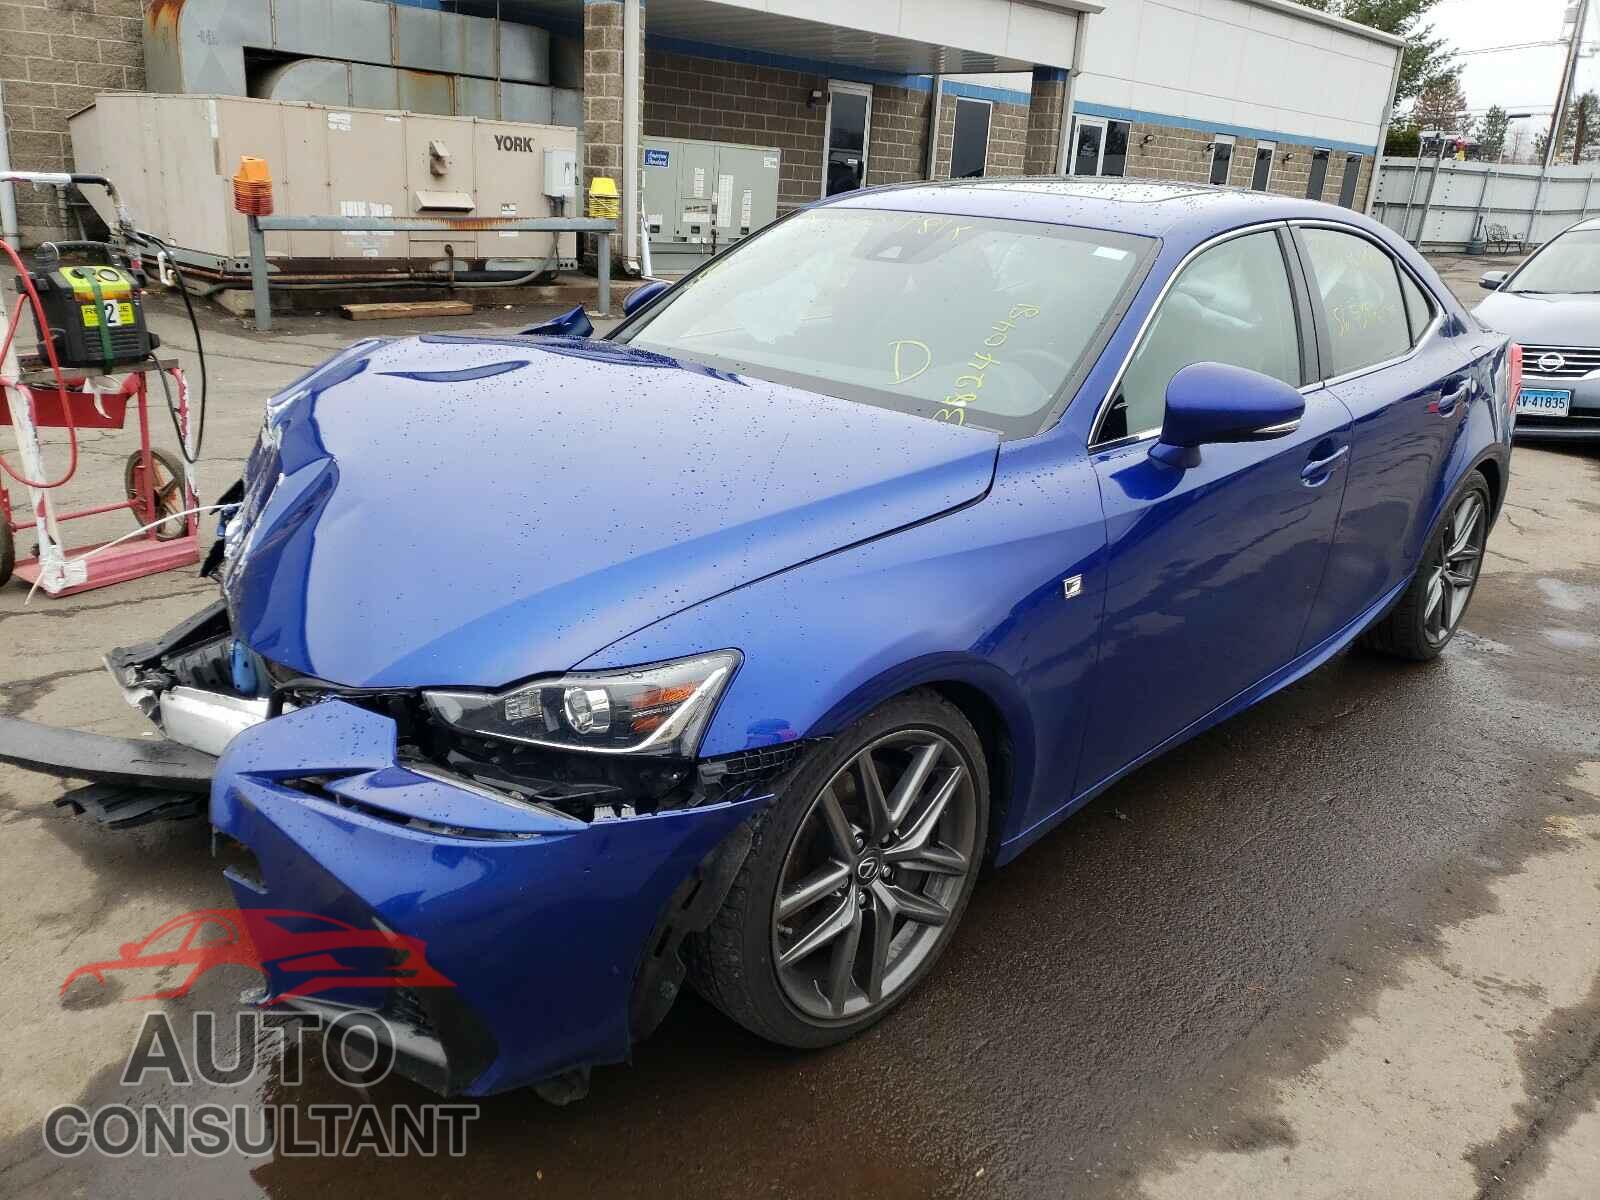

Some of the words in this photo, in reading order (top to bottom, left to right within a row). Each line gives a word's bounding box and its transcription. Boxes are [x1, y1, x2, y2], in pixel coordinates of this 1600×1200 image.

[494, 135, 533, 152] YORK
[104, 303, 117, 323] 2
[887, 339, 932, 385] D
